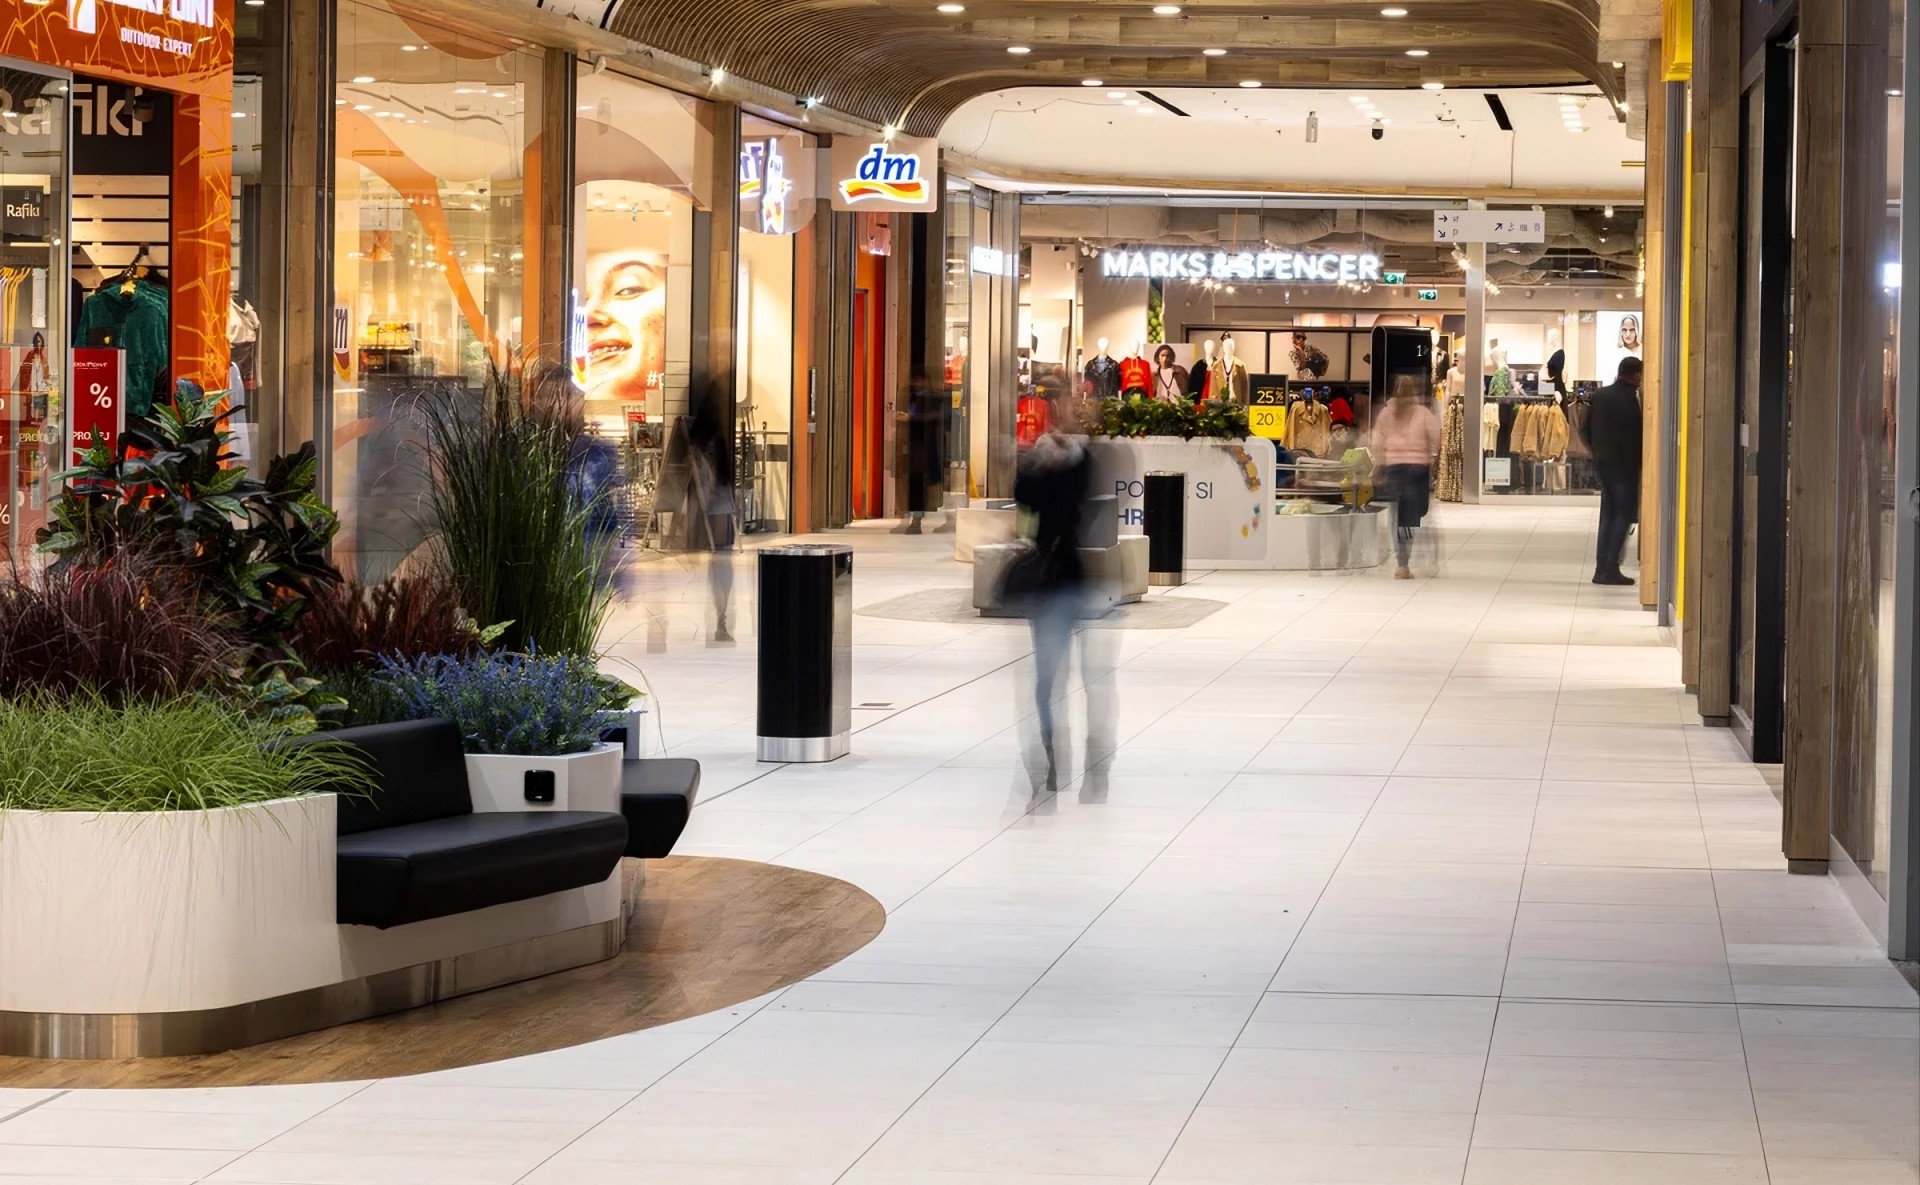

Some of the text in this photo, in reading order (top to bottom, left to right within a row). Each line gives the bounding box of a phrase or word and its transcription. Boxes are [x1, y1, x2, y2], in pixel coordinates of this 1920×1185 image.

[120, 27, 192, 57] OUTDOOR EXPERT
[859, 147, 917, 181] dm
[1103, 252, 1207, 278] MARKS
[1237, 252, 1380, 281] SPENCER
[1195, 481, 1213, 499] SI
